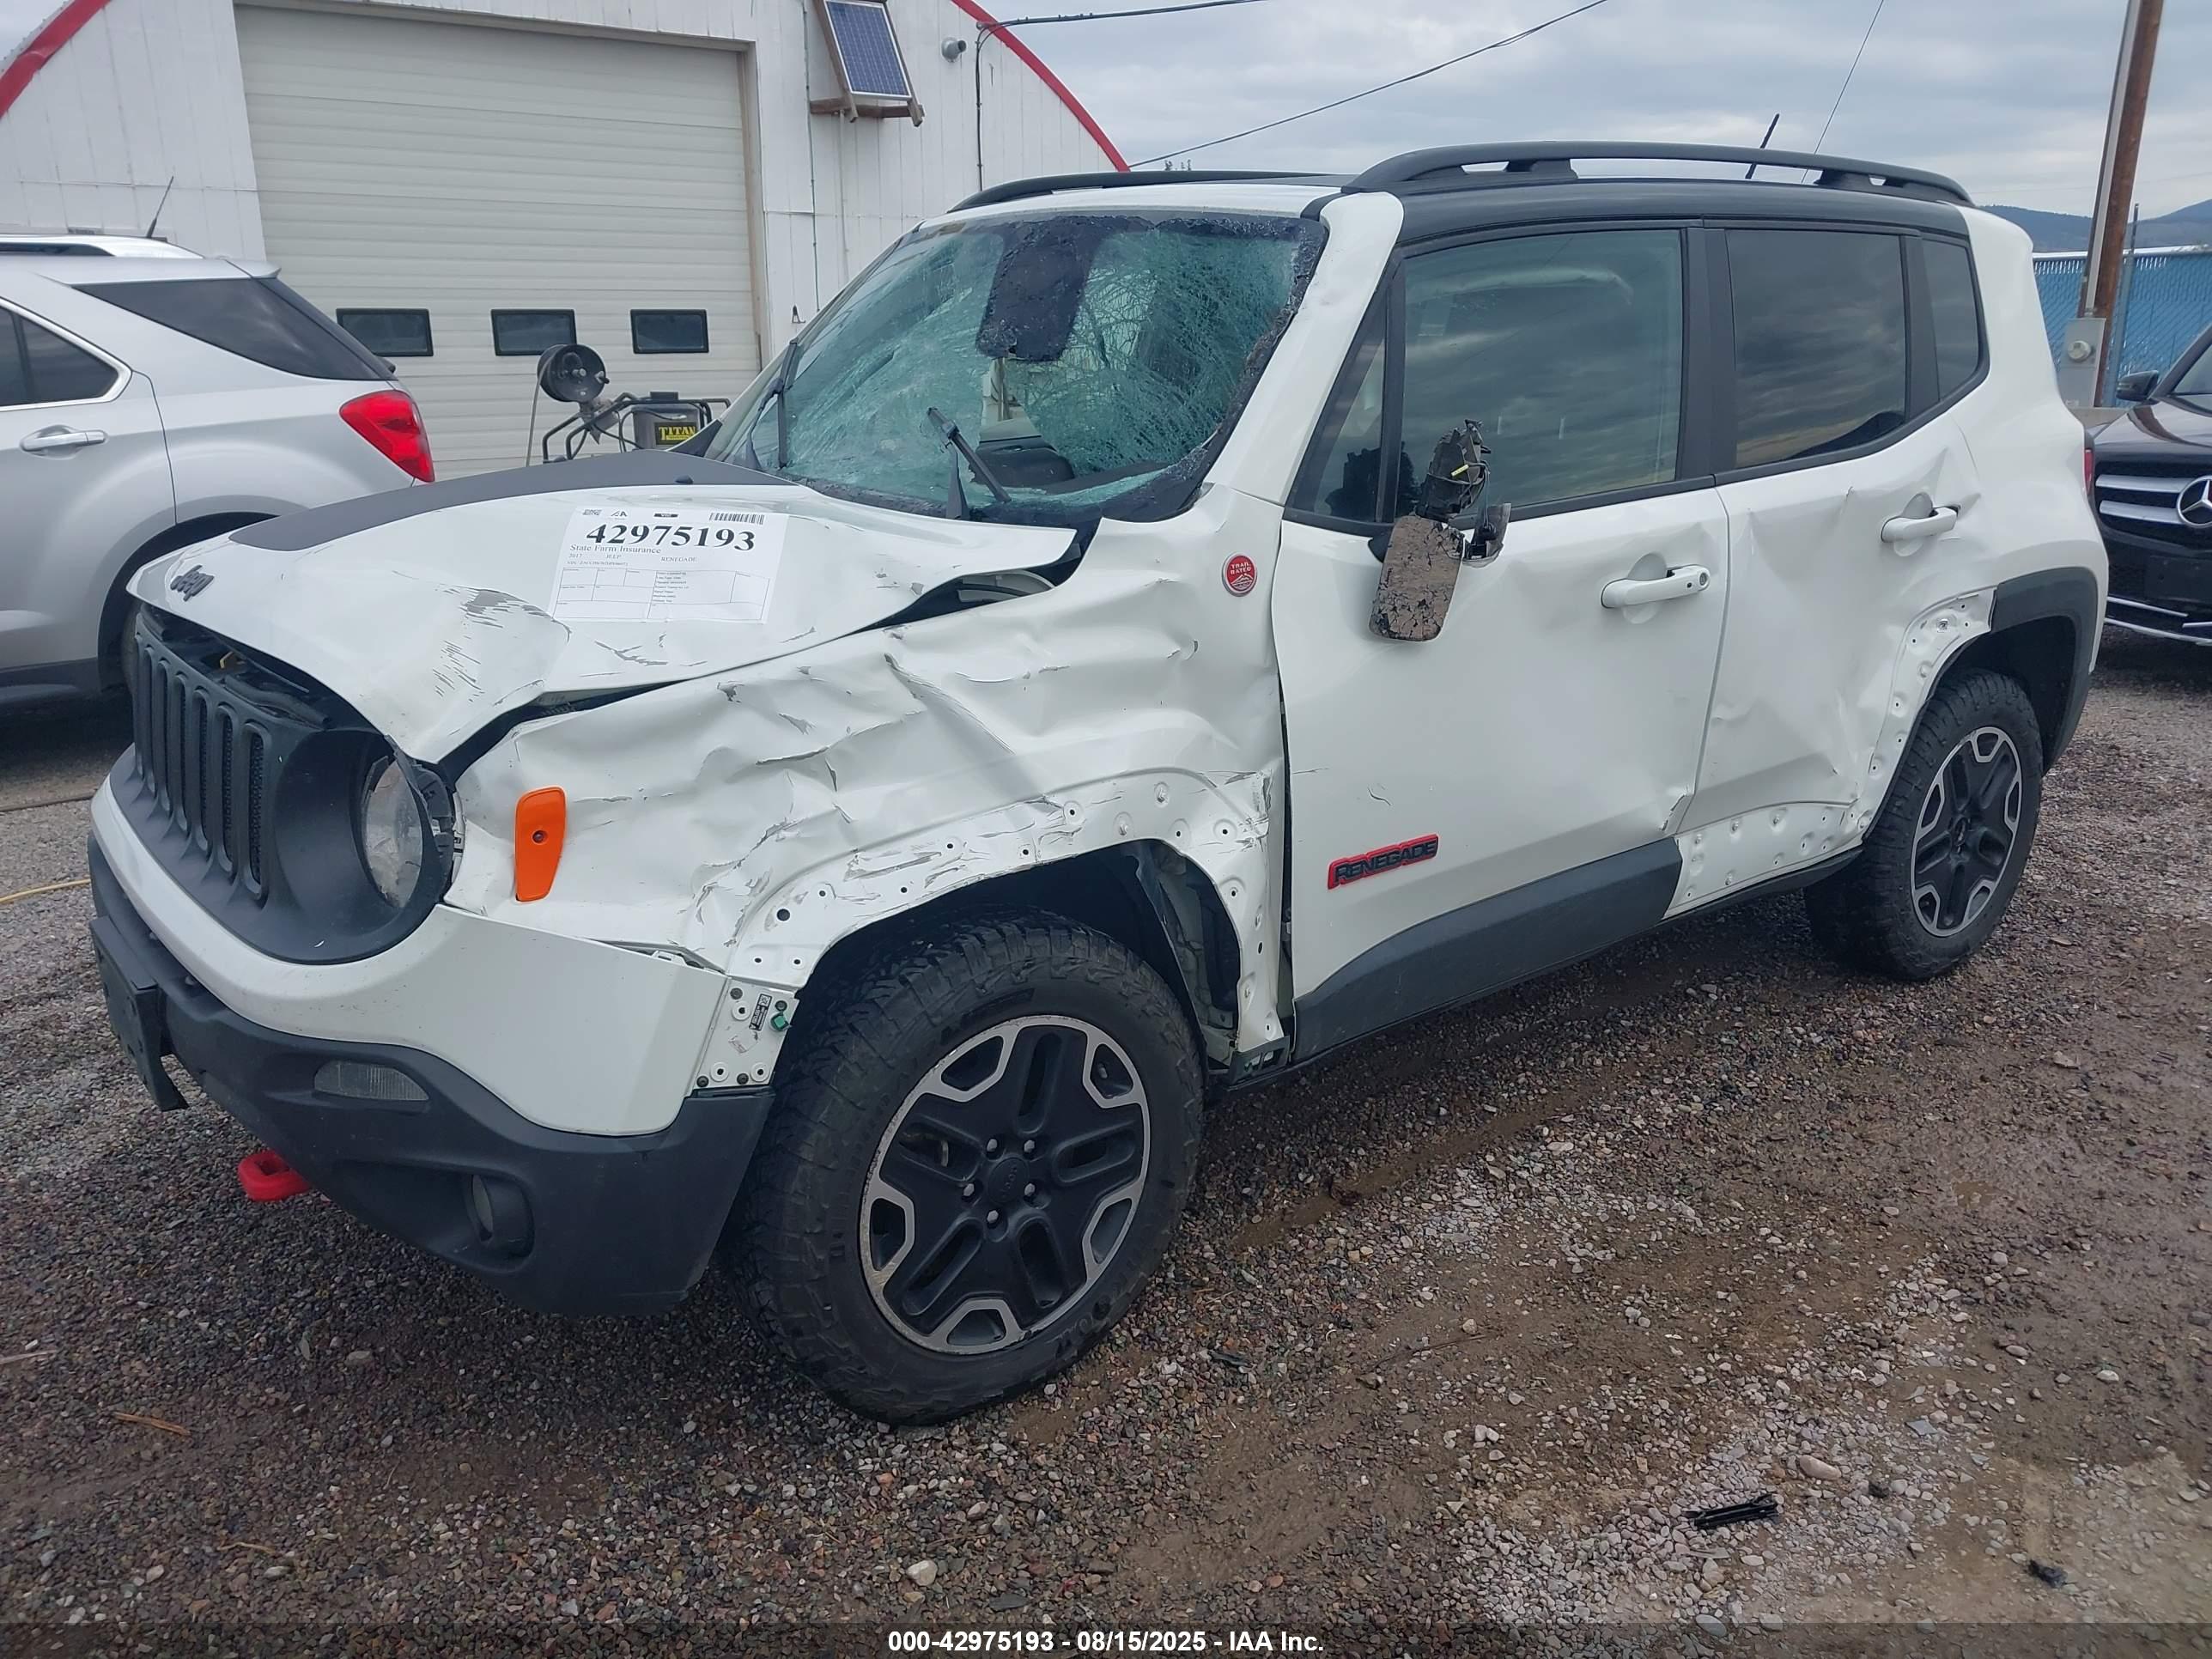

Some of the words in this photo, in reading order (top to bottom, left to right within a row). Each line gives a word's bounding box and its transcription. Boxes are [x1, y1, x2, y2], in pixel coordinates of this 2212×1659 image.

[658, 426, 696, 441] TITAN
[586, 524, 756, 551] 42975193
[619, 545, 661, 554] Insurance
[1231, 567, 1251, 575] RATED
[170, 564, 215, 602] Jeep
[1328, 834, 1439, 890] RENEGADE
